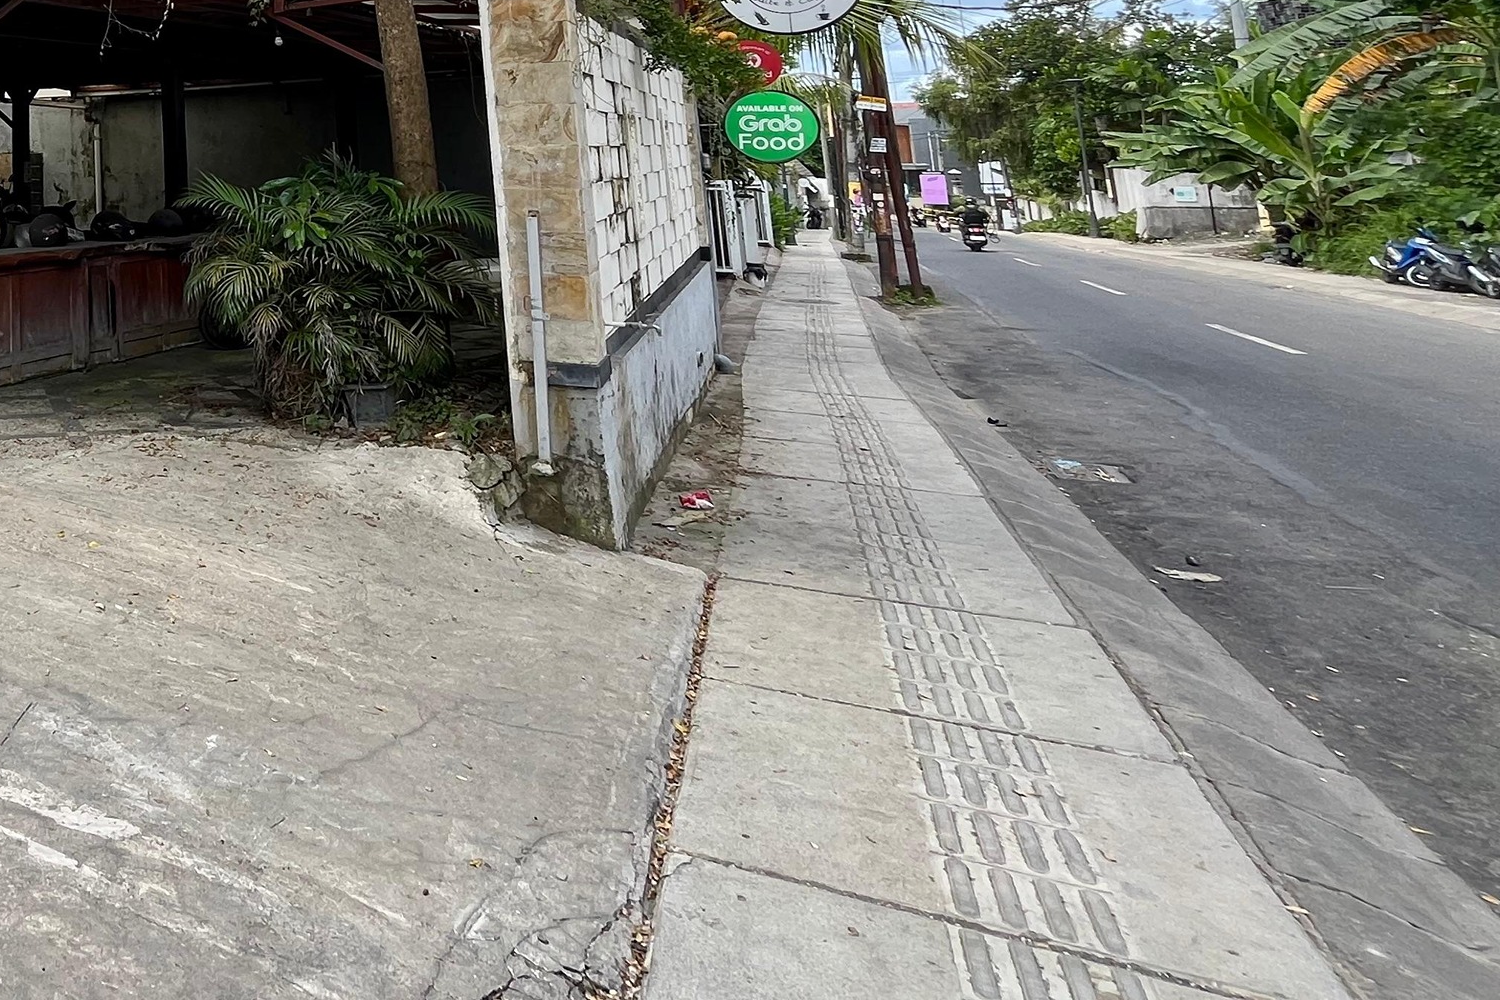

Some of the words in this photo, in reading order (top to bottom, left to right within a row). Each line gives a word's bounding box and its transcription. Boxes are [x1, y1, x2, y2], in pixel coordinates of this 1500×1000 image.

[784, 0, 795, 7] &
[736, 104, 787, 112] AVAILABLE
[788, 104, 803, 113] ON
[739, 114, 802, 132] Grab
[739, 133, 804, 150] Food
